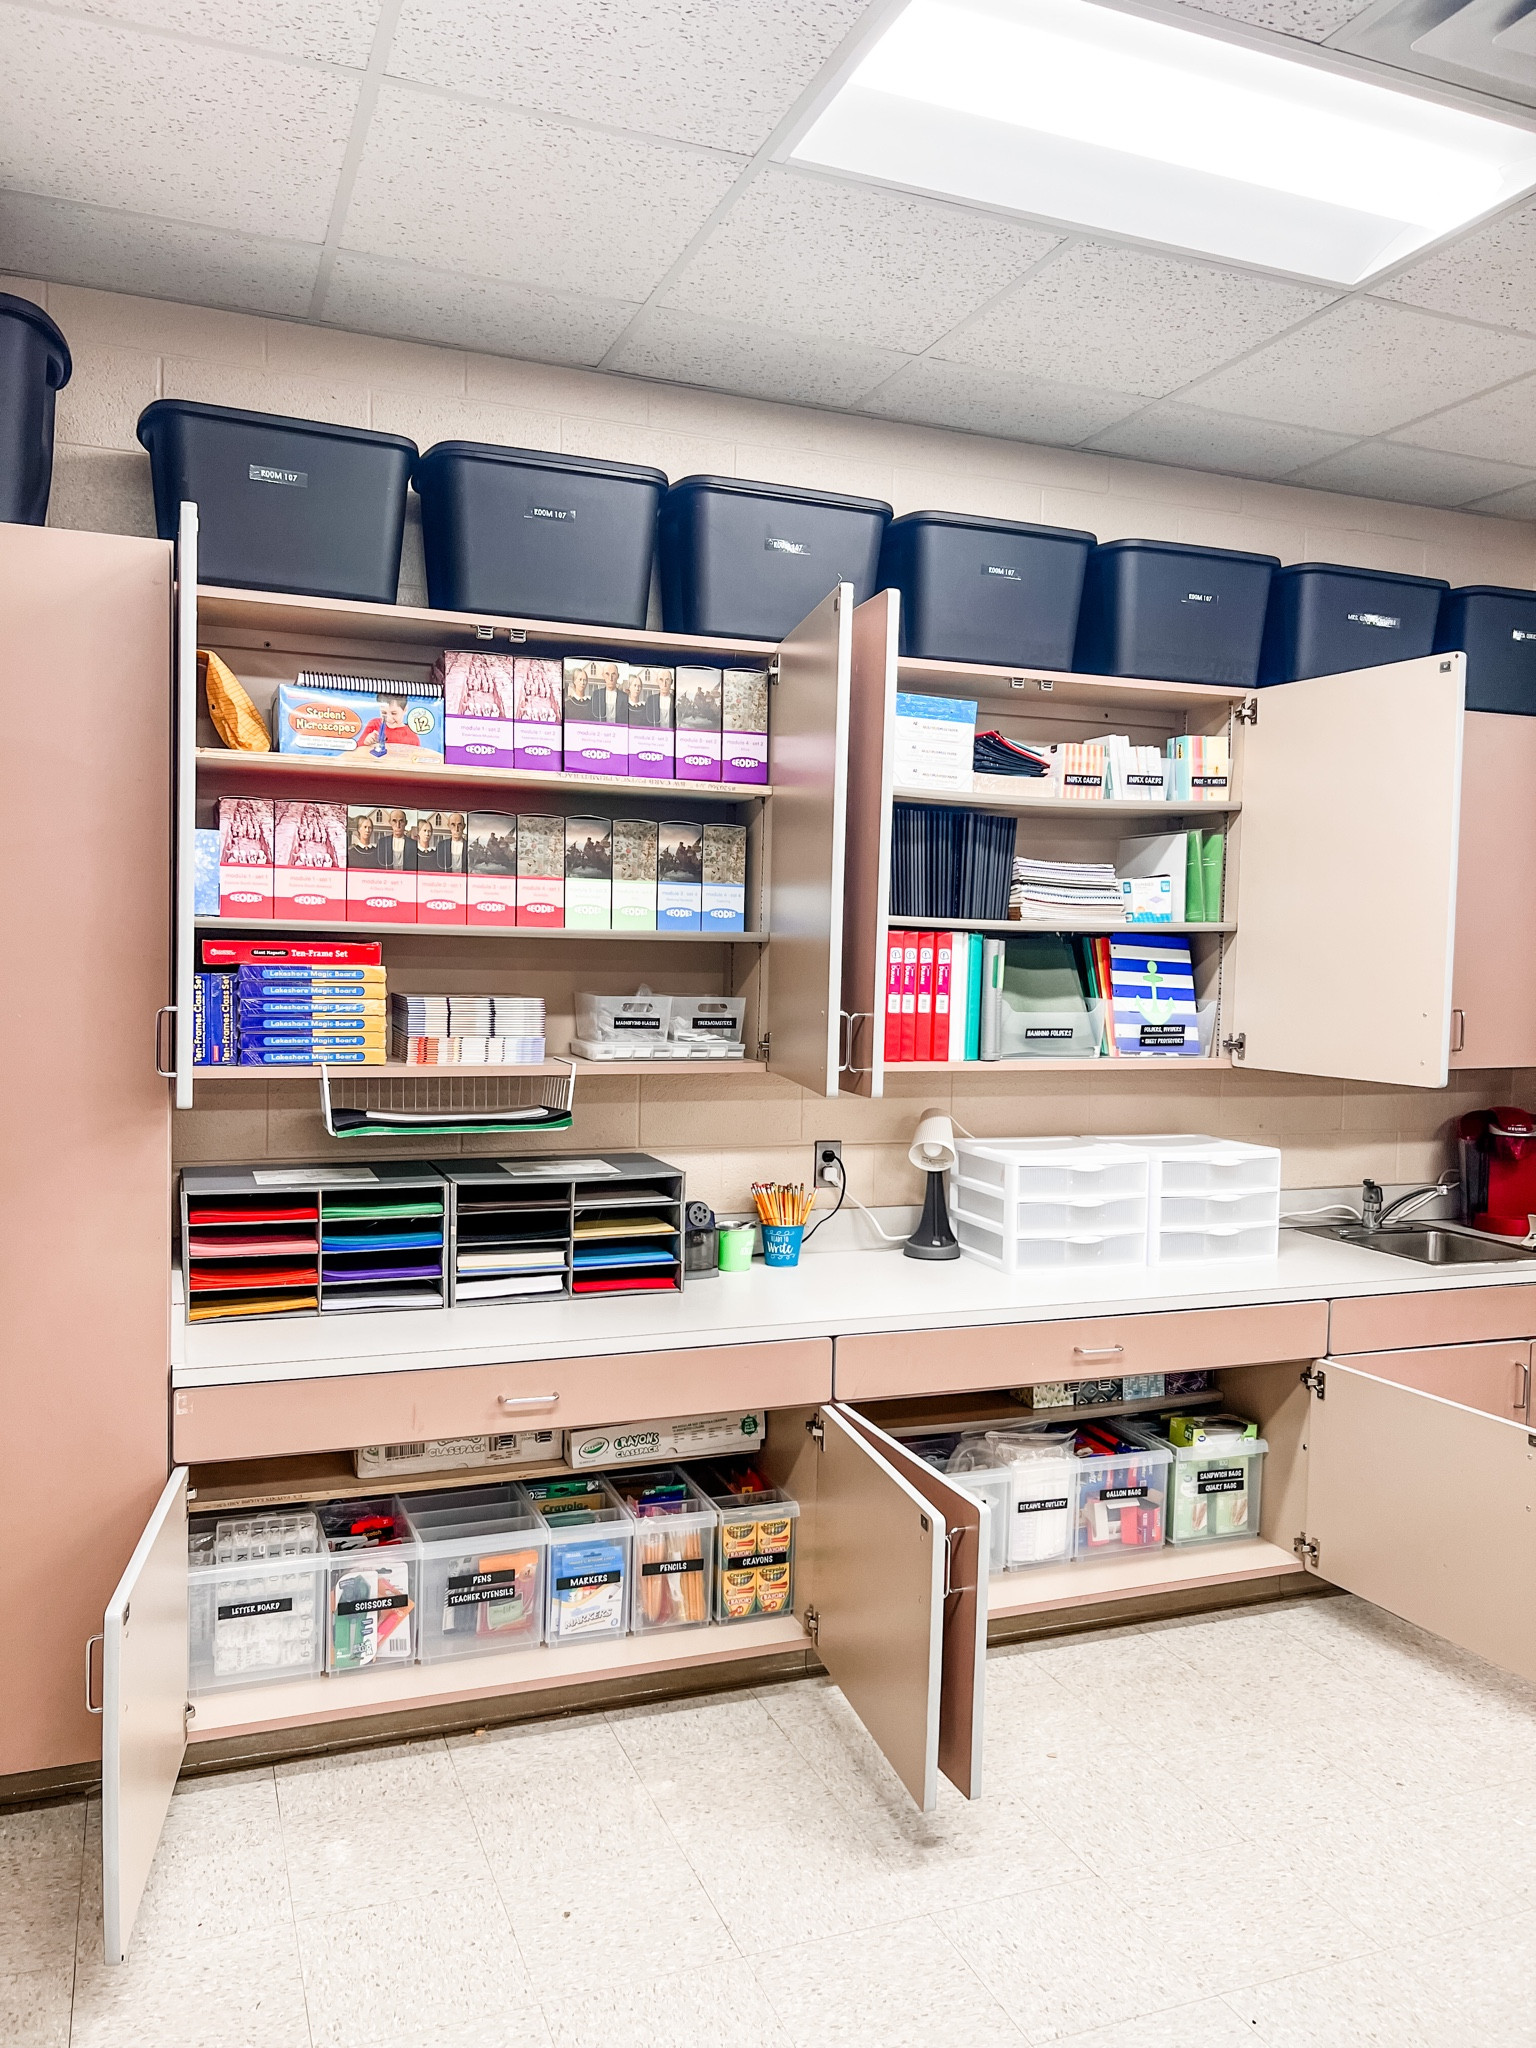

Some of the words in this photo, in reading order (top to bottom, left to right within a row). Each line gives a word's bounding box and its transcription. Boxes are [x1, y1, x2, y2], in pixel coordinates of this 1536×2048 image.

[261, 470, 282, 480] ROOM
[284, 474, 297, 482] 107
[534, 509, 553, 517] ROOM
[306, 707, 346, 720] Student
[296, 718, 356, 736] Microscopes
[1083, 776, 1100, 784] CARDS
[193, 975, 203, 990] Set
[221, 975, 231, 990] Set
[311, 987, 333, 995] Magic
[193, 990, 203, 1013] Class
[221, 990, 231, 1013] Class
[311, 1004, 333, 1012] Magic
[193, 1013, 203, 1063] Ten-Frames
[221, 1013, 231, 1062] Ten-Frames
[312, 1037, 334, 1045] Magic
[312, 1054, 334, 1062] Magic
[767, 1241, 793, 1254] Write
[613, 1432, 660, 1450] CRAYONS
[428, 1444, 486, 1457] CLASSPACK
[615, 1445, 659, 1458] CLASSPACK
[1200, 1471, 1227, 1480] SANDWICH
[1205, 1483, 1223, 1492] QUART
[1106, 1490, 1127, 1498] GALLON
[543, 1502, 583, 1513] Crayola
[764, 1520, 785, 1528] Crayola
[742, 1556, 773, 1566] CRAYONS
[659, 1562, 687, 1572] PENCILS
[762, 1566, 785, 1574] Crayola
[472, 1574, 492, 1585] PENS
[570, 1574, 608, 1587] MARKERS
[730, 1571, 752, 1579] Crayola
[451, 1592, 481, 1604] TEACHER
[482, 1588, 514, 1600] UTENSILS
[728, 1597, 752, 1606] CRAYONS
[231, 1605, 256, 1615] LETTER
[257, 1602, 280, 1611] BOARD
[355, 1598, 392, 1611] SCISSORS
